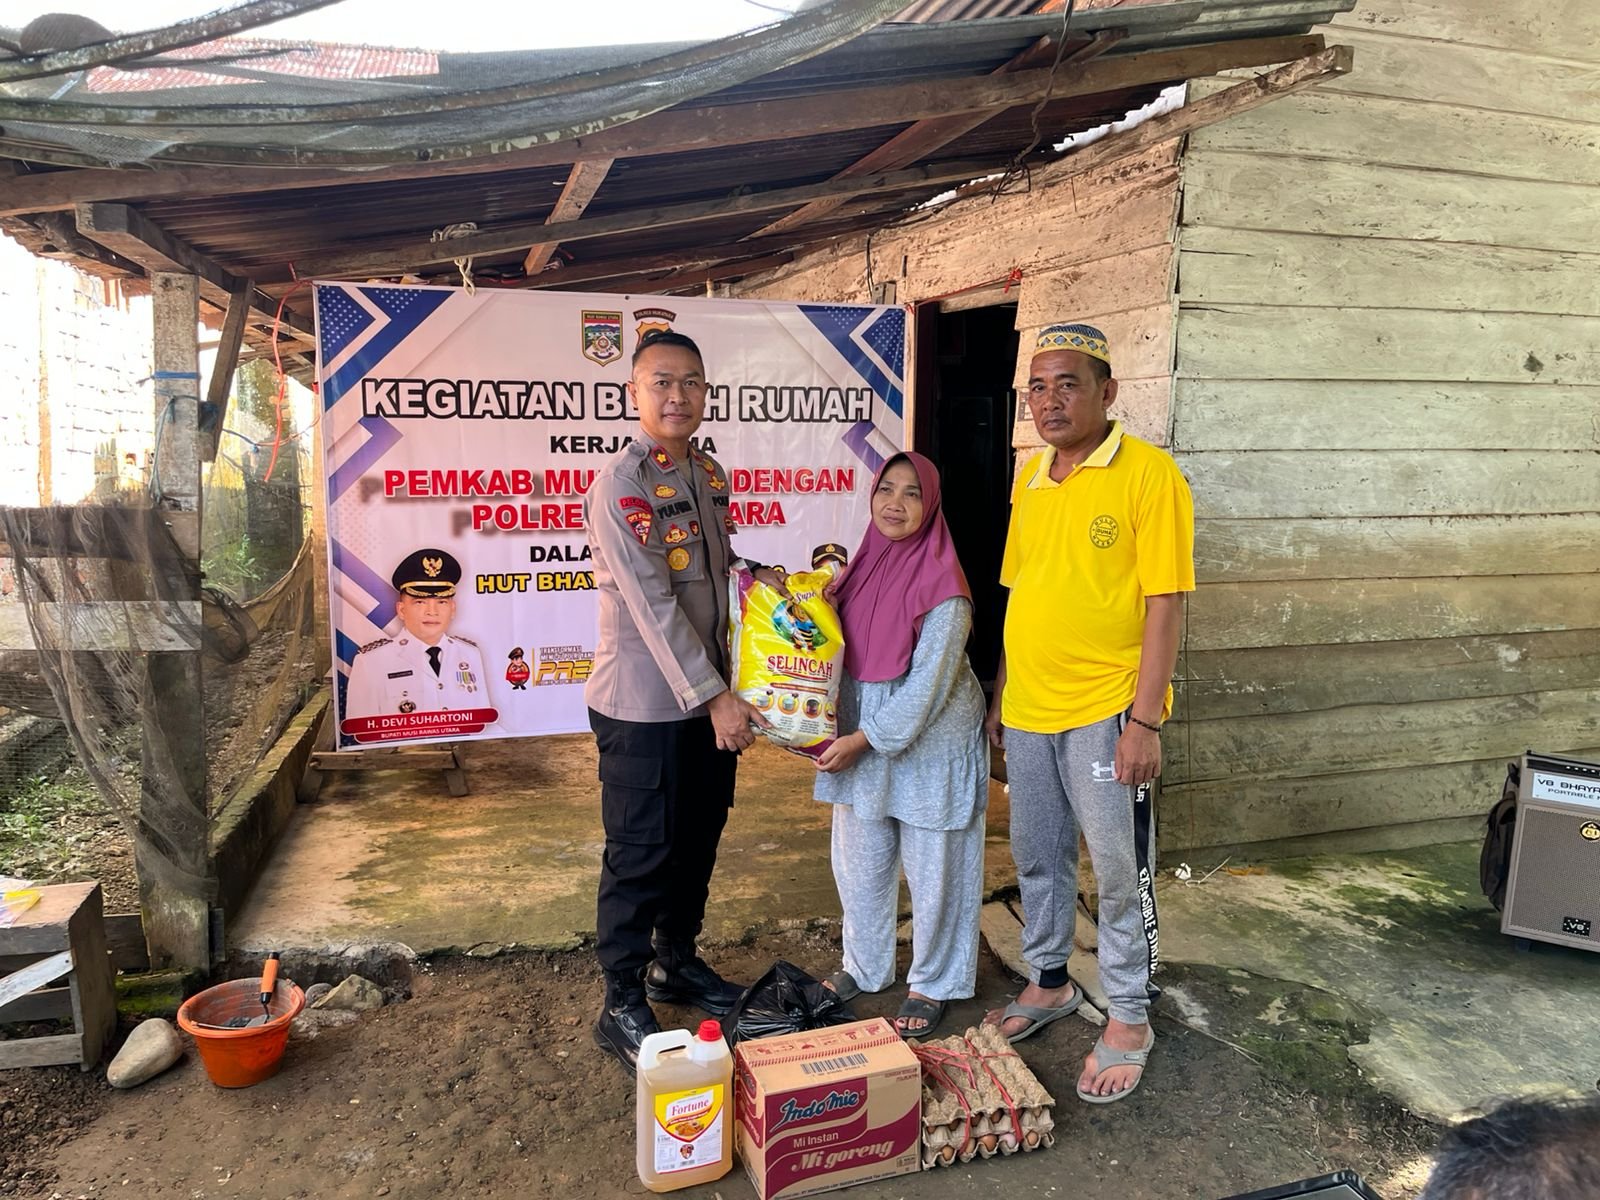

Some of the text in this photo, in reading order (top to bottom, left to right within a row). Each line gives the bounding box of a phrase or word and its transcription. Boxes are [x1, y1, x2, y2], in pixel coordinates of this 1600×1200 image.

[362, 379, 584, 419] KEGIATAN
[739, 385, 873, 423] RUMAH
[384, 470, 534, 496] PEMKAB
[732, 468, 855, 494] DENGAN
[473, 504, 584, 529] POLRE
[530, 545, 593, 562] DALA
[476, 572, 530, 594] HUT
[767, 655, 833, 677] SELINCAH
[367, 713, 473, 729] H. DEVI SUHARTONI
[381, 731, 401, 739] BUPATI
[1548, 789, 1594, 799] PORTABLE
[672, 1099, 709, 1116] Fortune
[793, 1132, 839, 1148] Mi Instan
[791, 1150, 824, 1172] Mi
[824, 1140, 895, 1169] goreng
